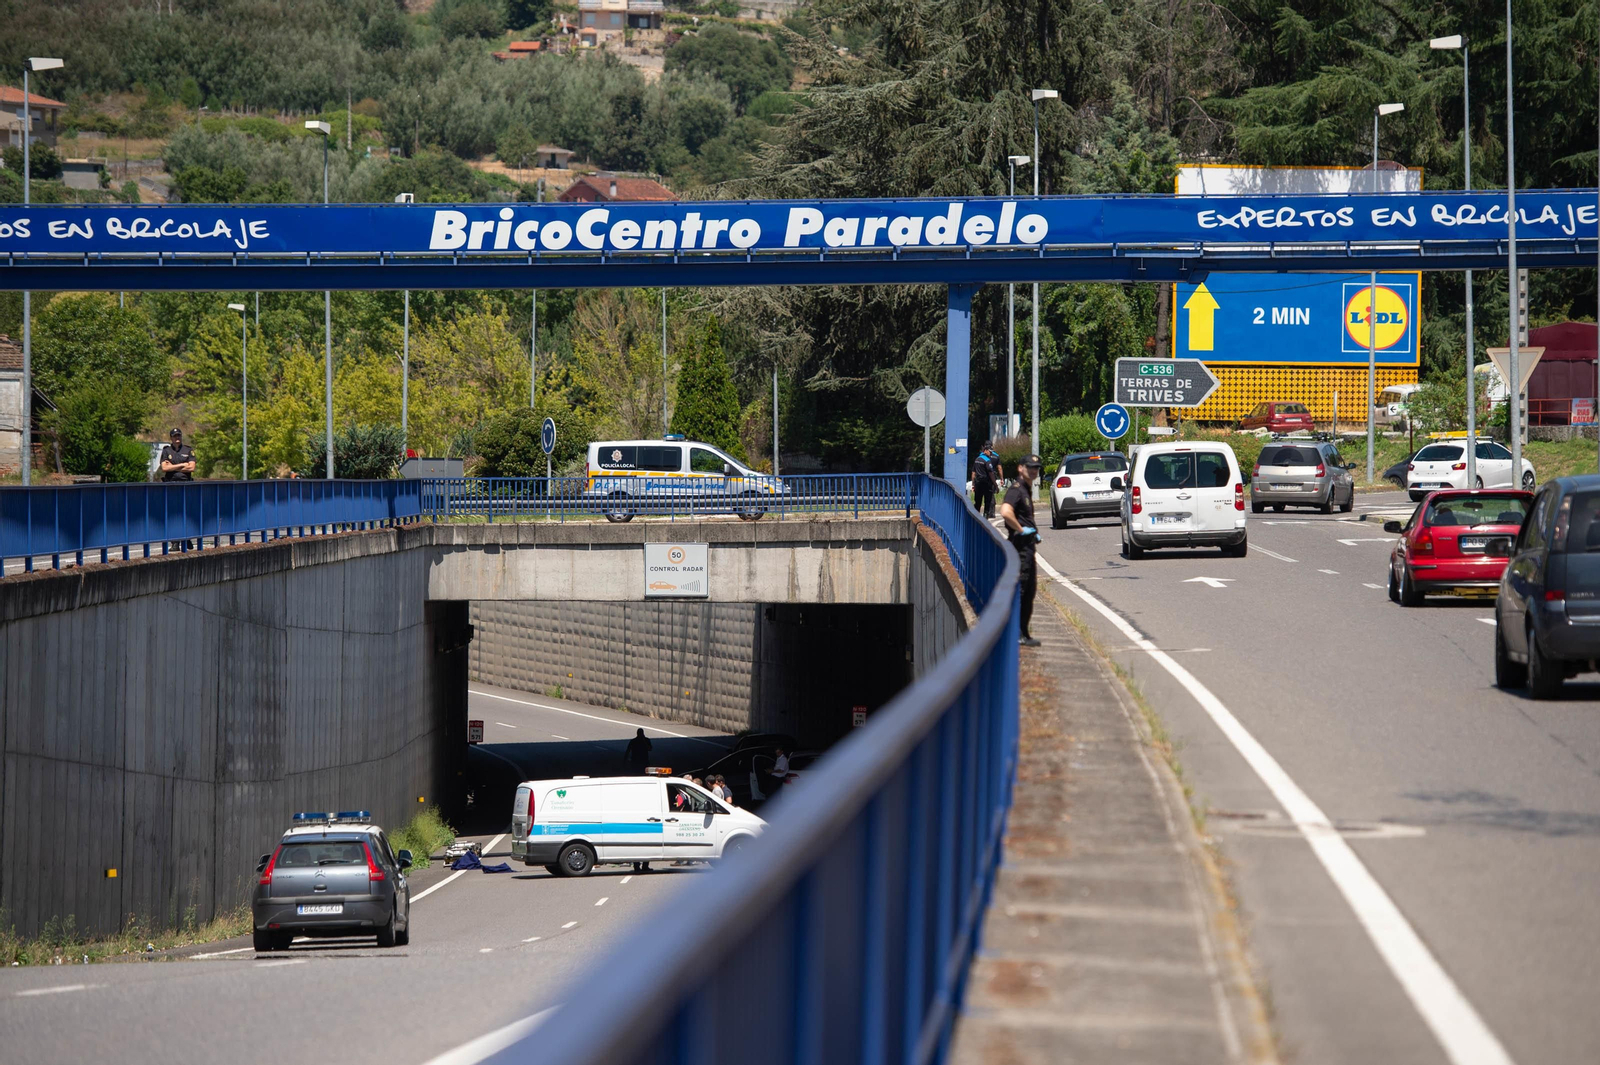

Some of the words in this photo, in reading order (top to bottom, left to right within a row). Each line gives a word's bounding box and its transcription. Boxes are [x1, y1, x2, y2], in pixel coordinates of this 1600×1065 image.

[429, 207, 761, 250] BricoCentro
[783, 202, 1048, 248] Paradelo
[1197, 206, 1354, 229] EXPERTOS
[1371, 206, 1417, 227] EN
[1431, 204, 1599, 236] BRICOLAJE
[48, 218, 94, 239] EN
[106, 217, 270, 249] BRICOLAJE
[1253, 307, 1265, 325] 2
[1272, 307, 1311, 325] MIN
[1140, 365, 1172, 374] C-536
[1120, 377, 1169, 388] TERRAS
[1176, 378, 1192, 388] DE
[1127, 389, 1185, 402] TRIVES
[671, 551, 682, 559] 50
